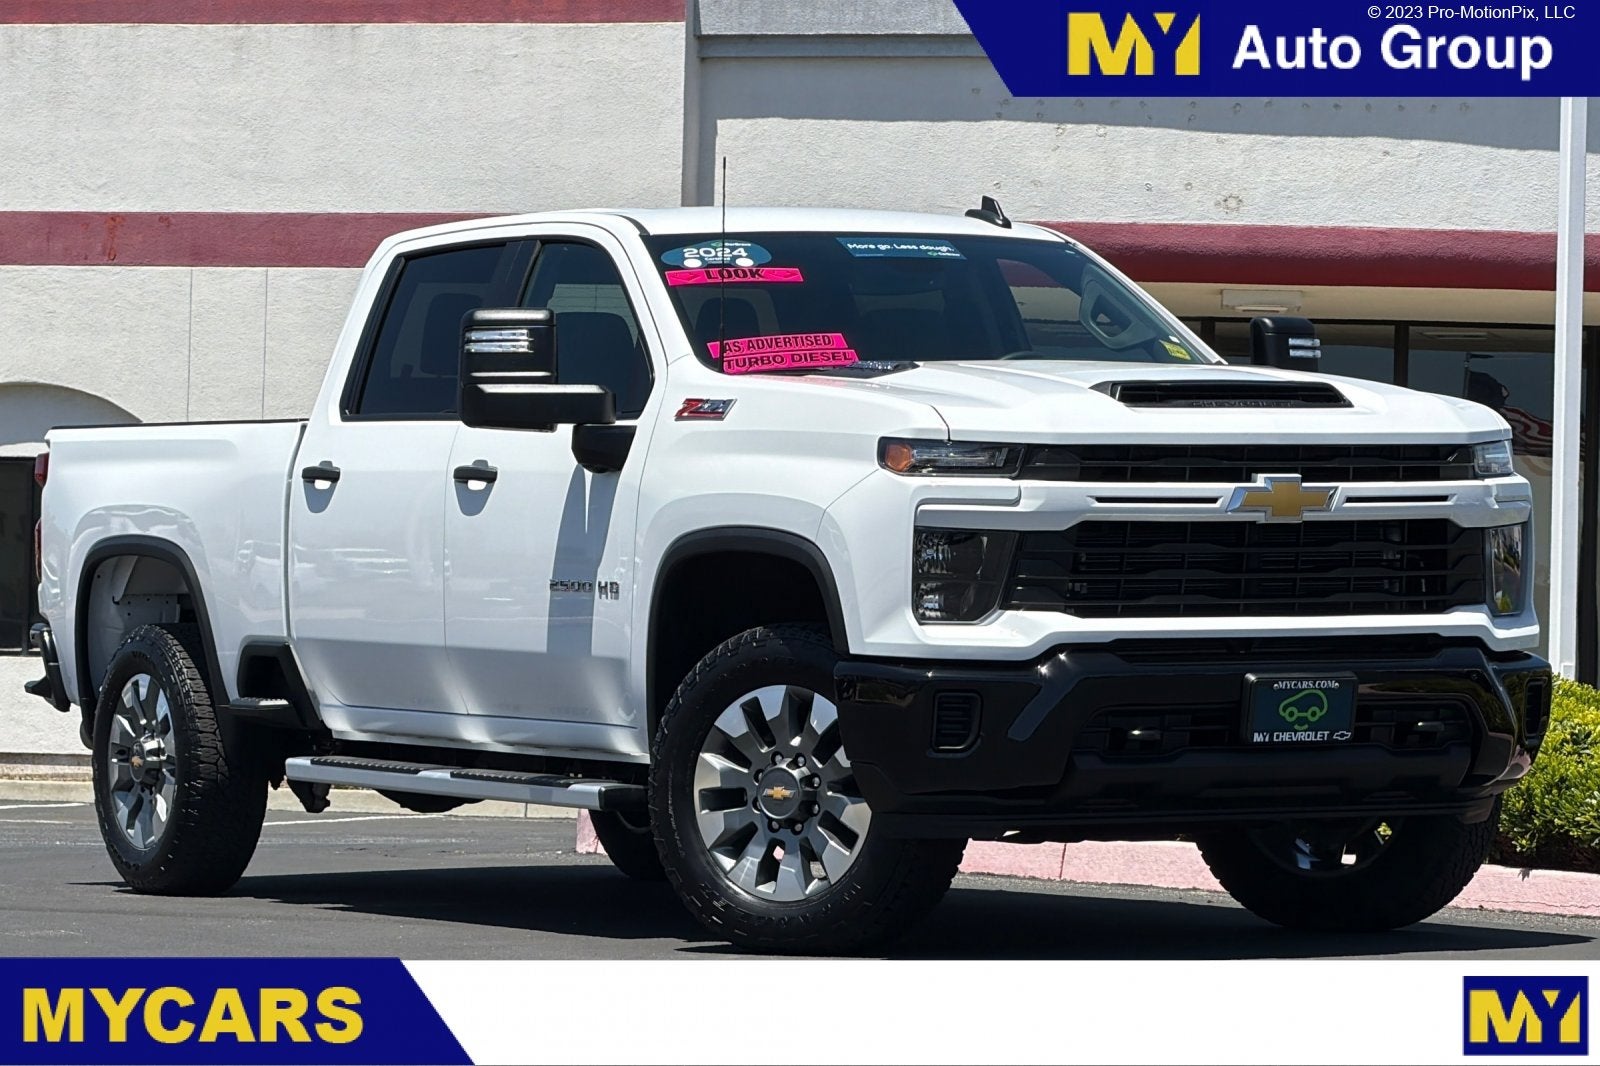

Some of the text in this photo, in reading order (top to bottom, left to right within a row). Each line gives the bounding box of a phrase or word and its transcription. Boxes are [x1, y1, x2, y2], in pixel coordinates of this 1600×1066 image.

[683, 247, 748, 258] 2024
[704, 268, 766, 280] LOOK
[723, 334, 834, 354] AS ADVERTISED
[723, 351, 853, 370] TURBO DIESEL
[550, 579, 593, 592] 2500
[1278, 680, 1336, 689] MYCARS.COM
[1253, 731, 1330, 742] MY CHEVROLET
